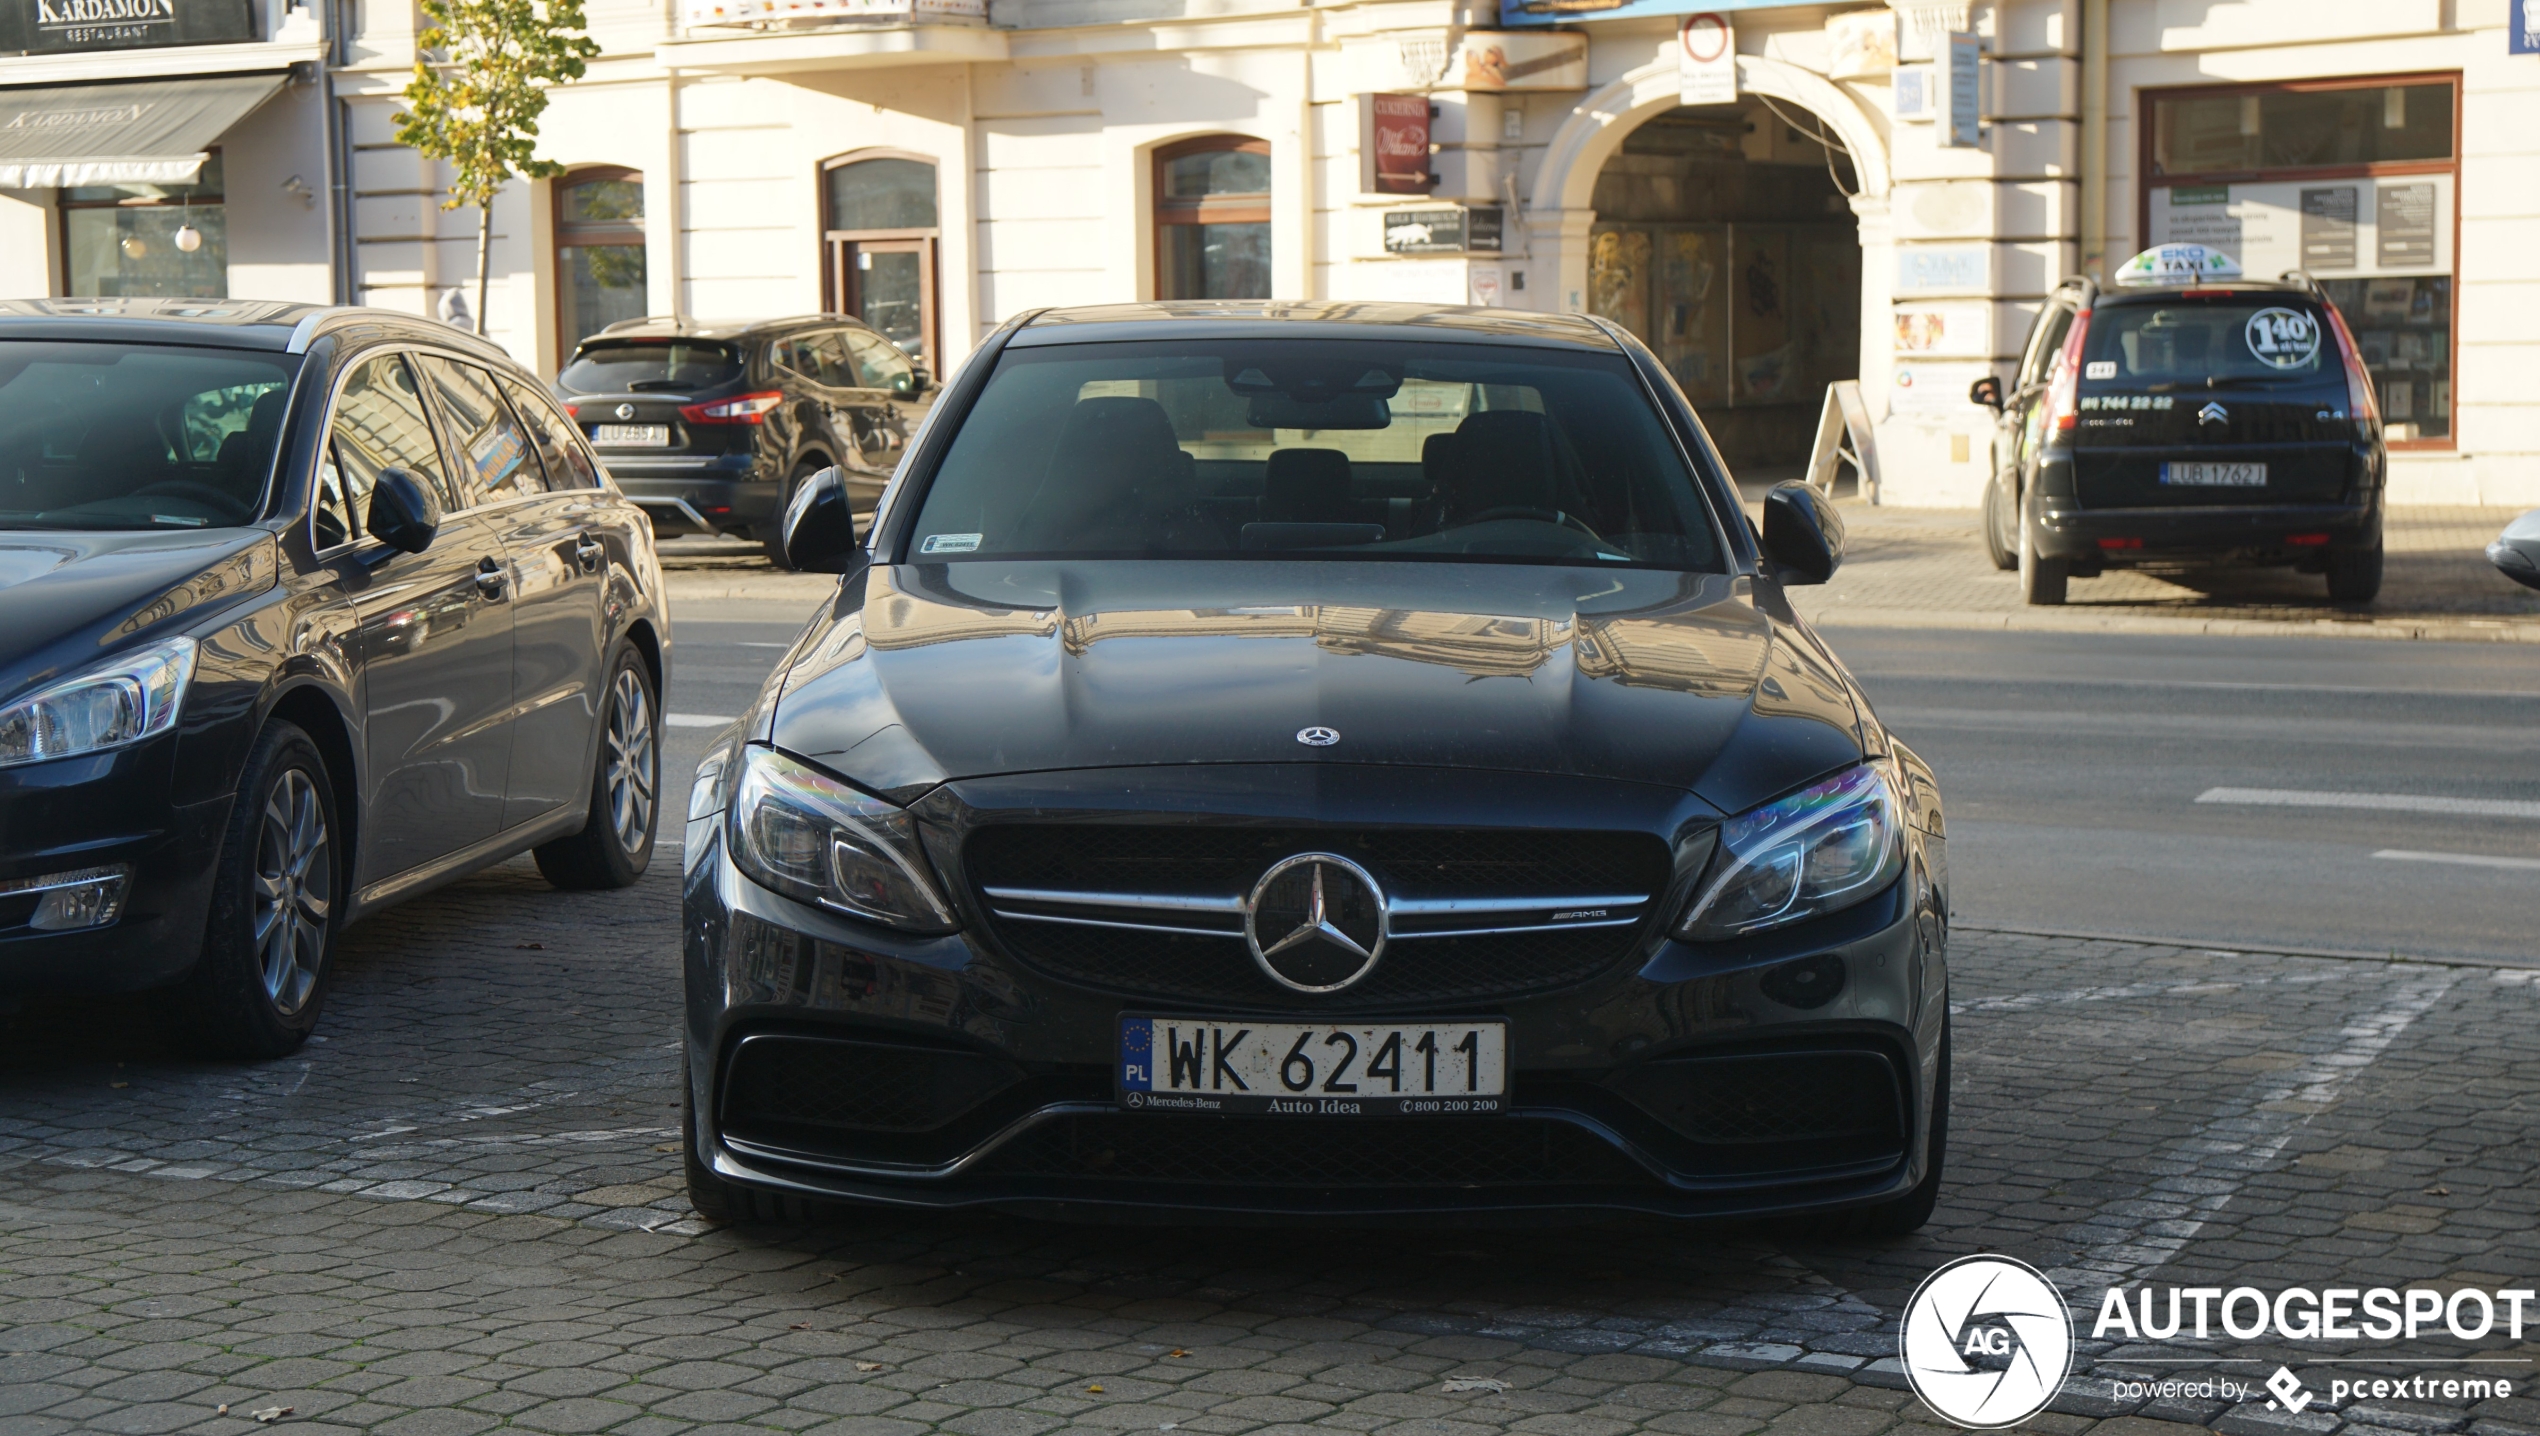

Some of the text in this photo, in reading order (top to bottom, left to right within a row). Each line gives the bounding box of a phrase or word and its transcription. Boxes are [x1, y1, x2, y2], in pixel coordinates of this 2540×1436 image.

[38, 0, 174, 23] KARDAMON
[66, 25, 149, 42] RESTAURANT
[5, 103, 156, 129] KARDAMON
[1374, 100, 1427, 117] CUKIERNIA
[2161, 246, 2204, 258] EKO
[2163, 261, 2204, 270] TAXI
[2101, 396, 2130, 410] 744
[2130, 396, 2151, 410] 22
[2152, 396, 2174, 410] 22
[2170, 463, 2262, 483] LUB 1762J
[1570, 909, 1607, 919] AMG
[1168, 1026, 1478, 1093] WK 62411
[1126, 1065, 1148, 1082] PL
[1146, 1095, 1221, 1109] Mercedes-Benz
[1267, 1098, 1362, 1114] Auto Idea
[1414, 1099, 1498, 1112] 800 200 200
